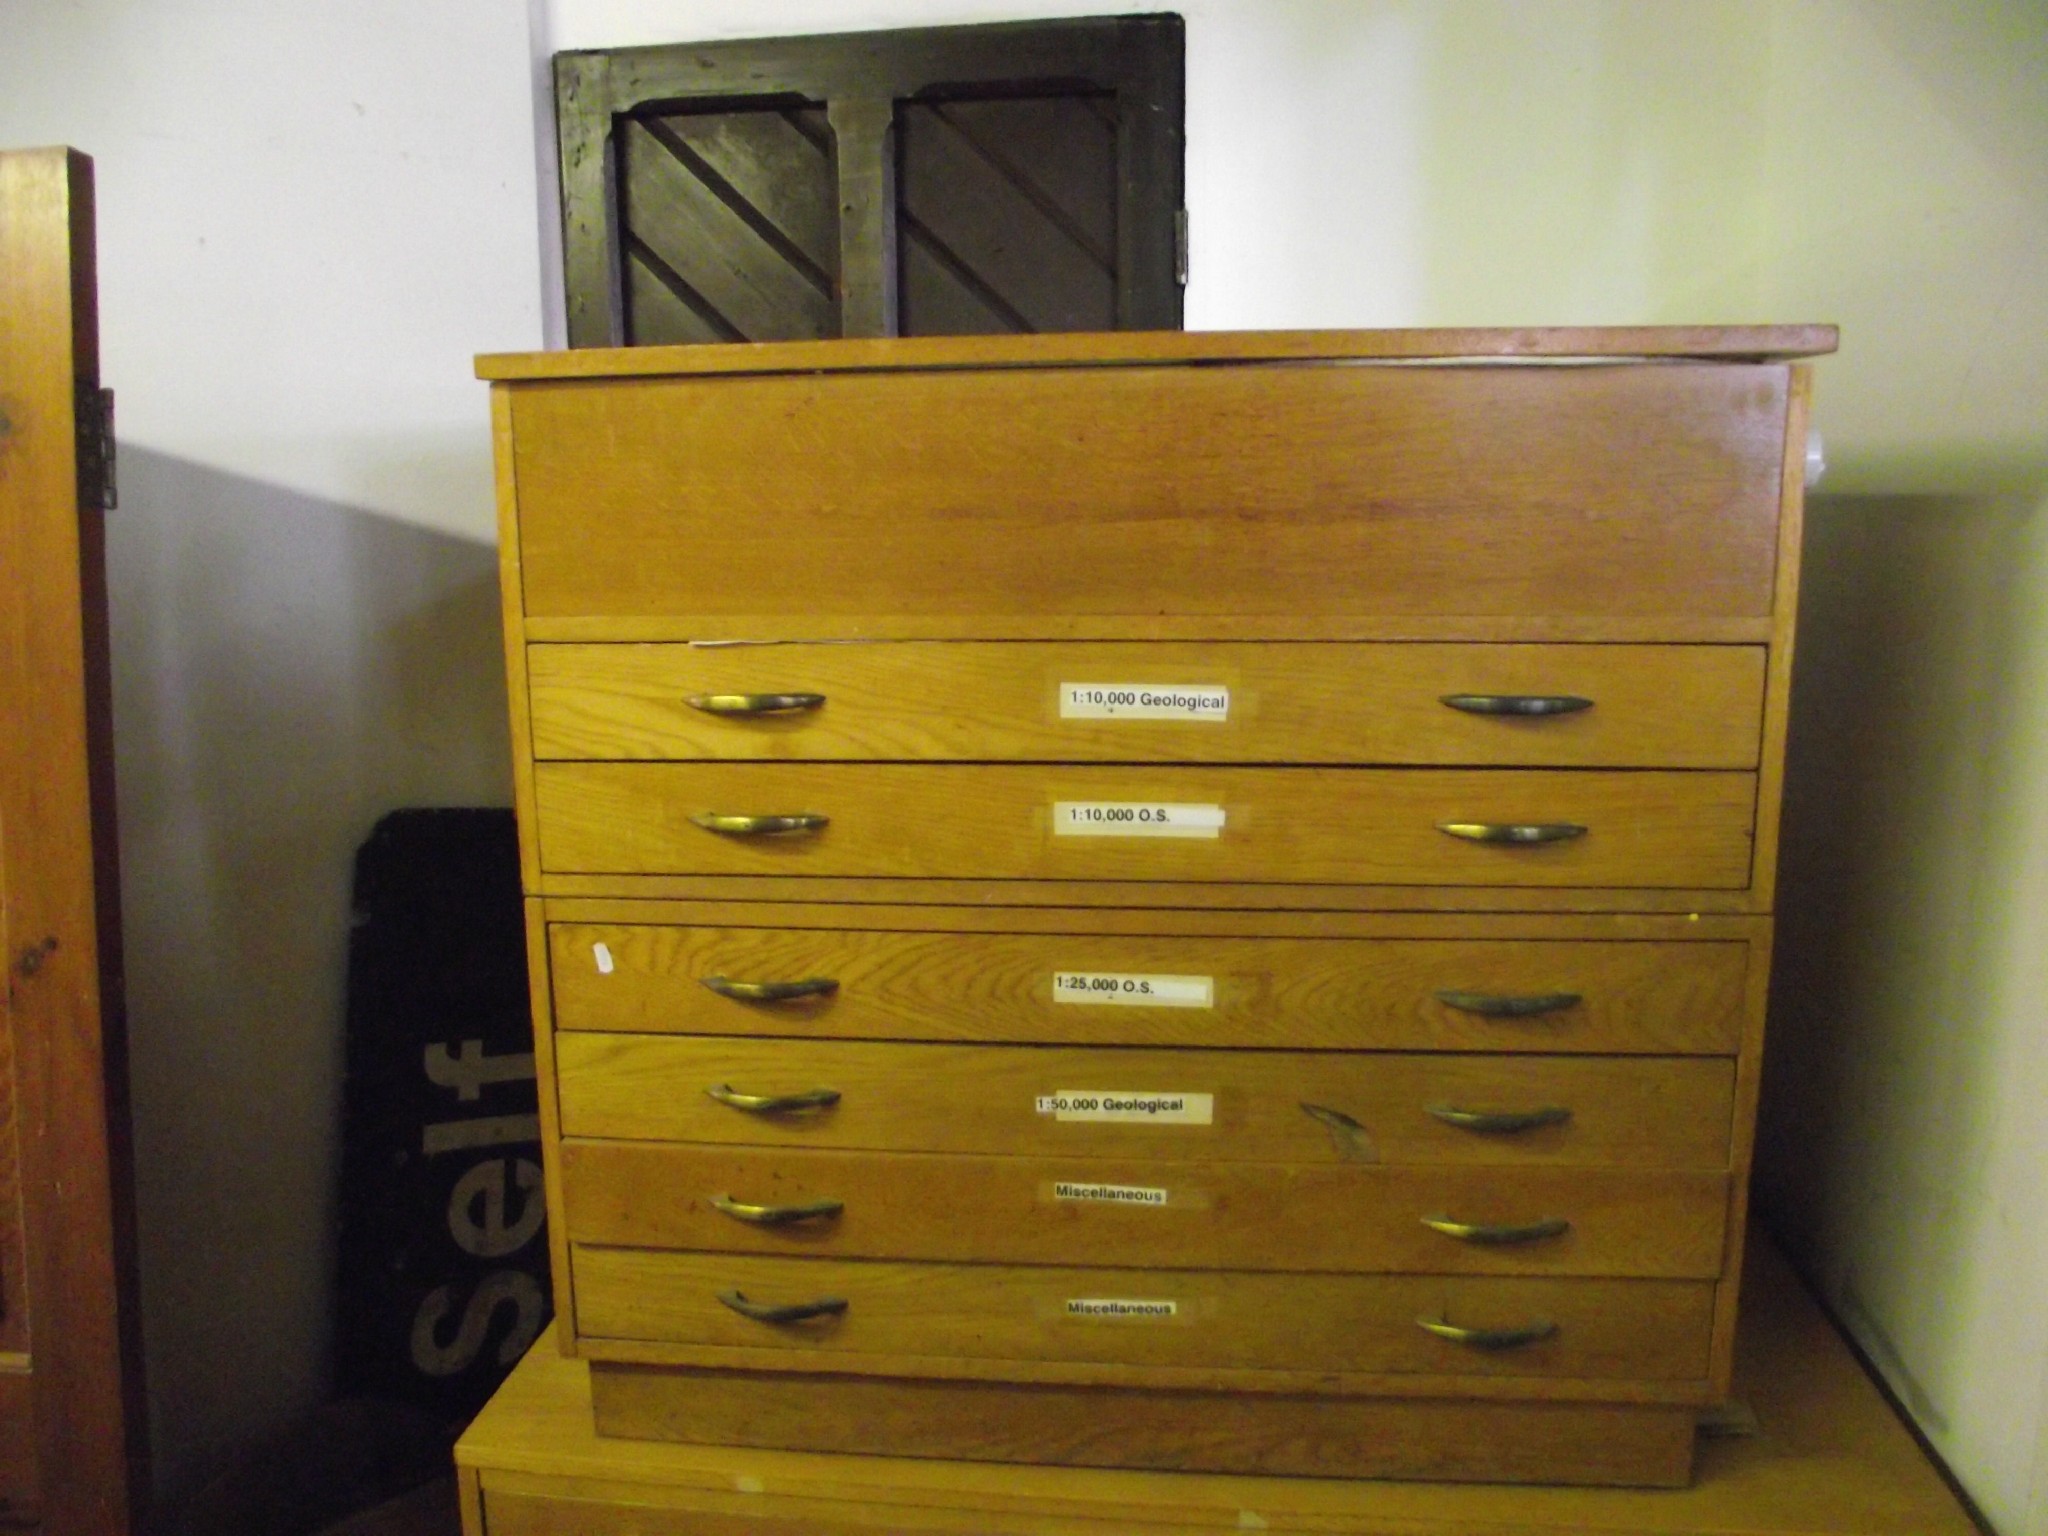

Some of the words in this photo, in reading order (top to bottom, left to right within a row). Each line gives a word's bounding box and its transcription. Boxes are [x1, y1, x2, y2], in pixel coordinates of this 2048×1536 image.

[1071, 690, 1135, 707] 1:10,000
[1140, 692, 1225, 711] Geological
[1071, 808, 1134, 823] 1:10,000
[1139, 808, 1170, 822] O.S.
[1056, 976, 1118, 992] 1:25,000
[1123, 981, 1154, 994] O.S.
[1038, 1098, 1098, 1112] 1:50,000
[1103, 1098, 1183, 1113] Geological
[1056, 1184, 1162, 1203] Miscellaneous
[411, 1038, 547, 1377] Self
[1068, 1302, 1171, 1315] Miscellaneous
